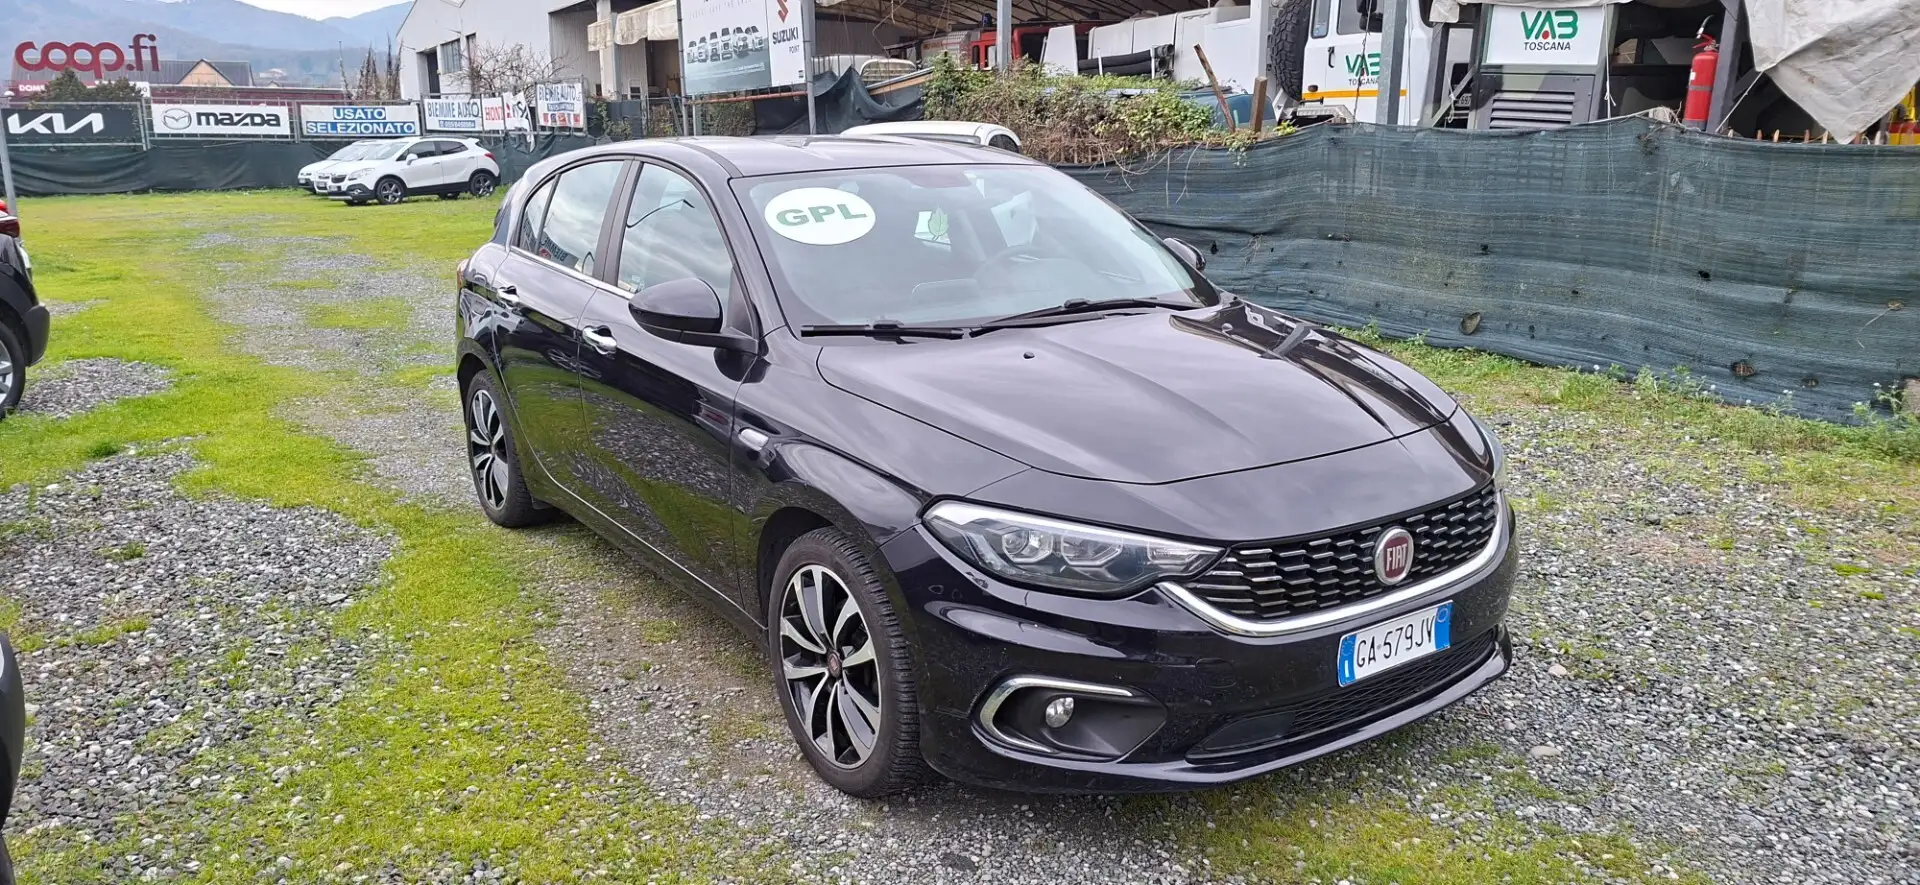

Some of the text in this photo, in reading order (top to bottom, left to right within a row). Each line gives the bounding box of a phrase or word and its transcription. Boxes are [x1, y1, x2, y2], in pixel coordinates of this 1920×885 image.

[1521, 10, 1578, 40] VAB
[772, 27, 799, 45] SUZUKI
[789, 45, 800, 54] POINT
[1524, 42, 1571, 51] TOSCANA
[15, 33, 160, 79] coop.fi
[333, 107, 386, 120] USATO
[457, 102, 480, 118] AUTO
[306, 122, 415, 133] SELEZIONATO
[776, 203, 868, 227] GPL
[1386, 543, 1408, 572] FIAT
